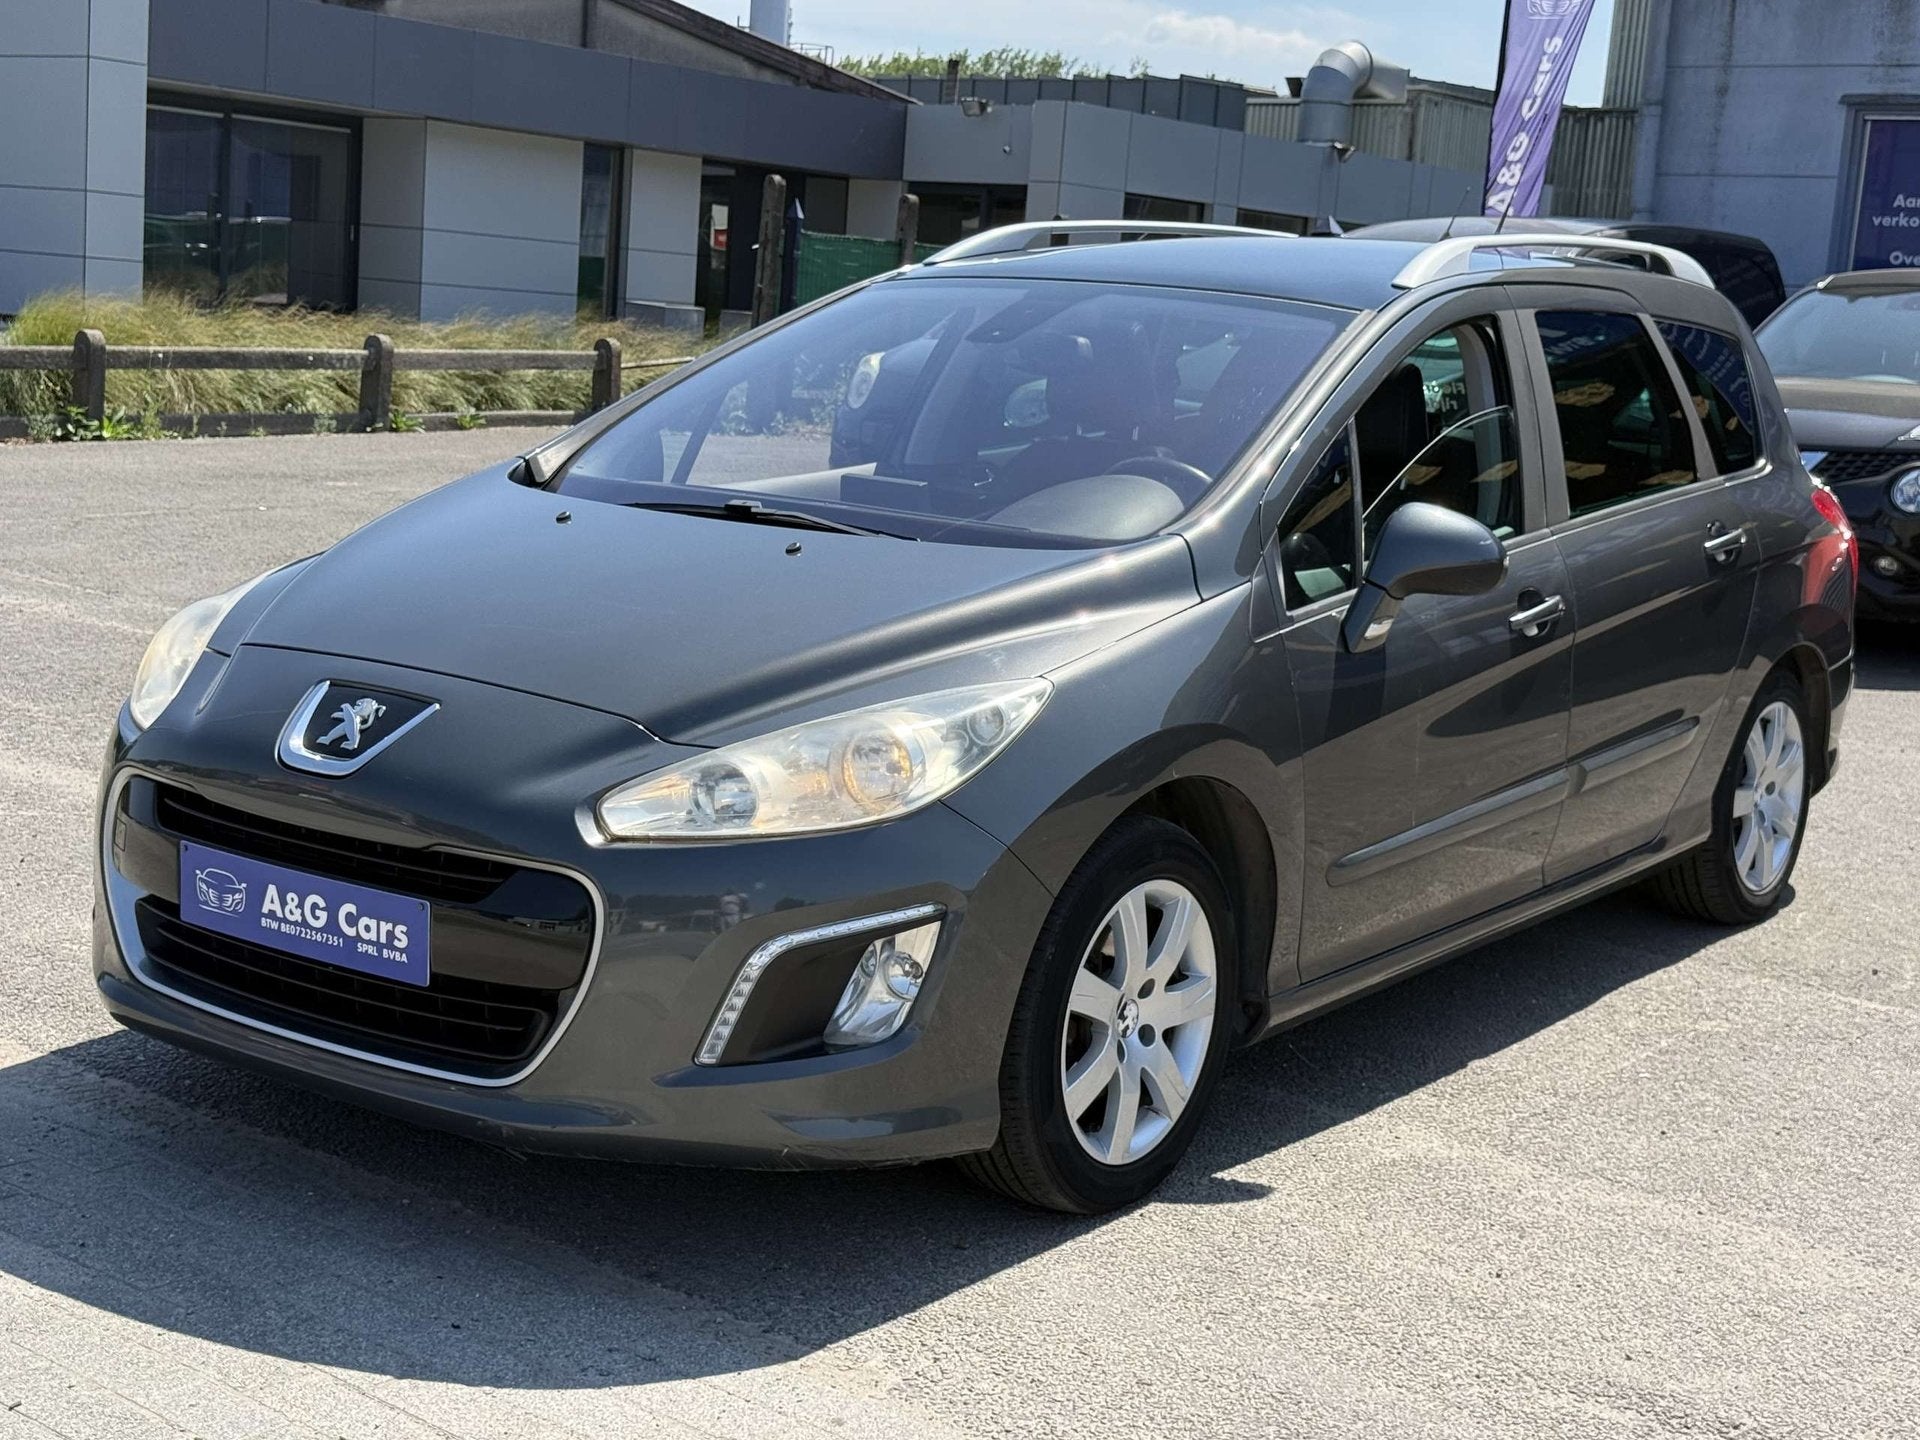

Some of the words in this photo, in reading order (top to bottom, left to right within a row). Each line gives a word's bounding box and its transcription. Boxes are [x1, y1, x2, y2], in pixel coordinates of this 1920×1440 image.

[1521, 36, 1562, 121] Cars
[261, 884, 328, 928] A&G
[338, 903, 409, 949] Cars
[261, 917, 279, 931] BTW
[281, 922, 343, 948] BE0722567351
[357, 942, 378, 956] SPRL
[383, 948, 408, 963] BVBA
